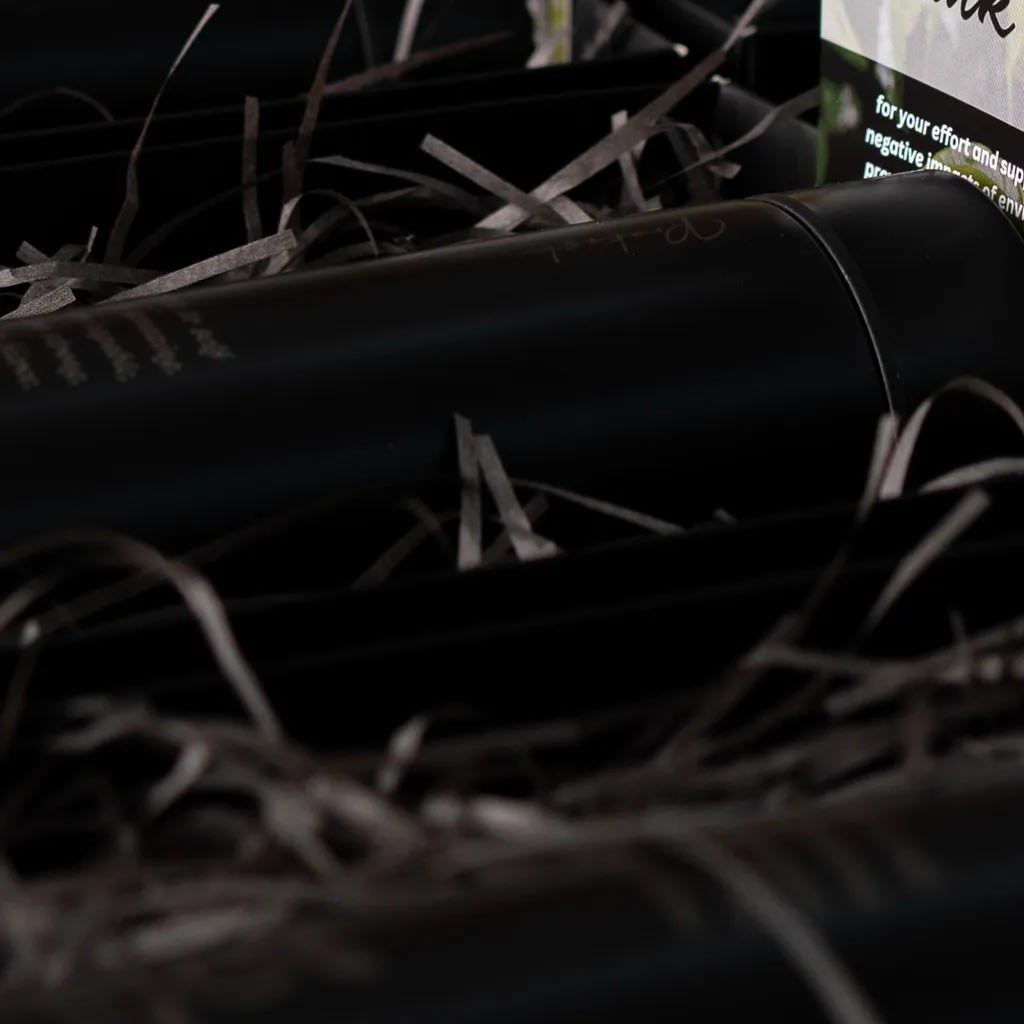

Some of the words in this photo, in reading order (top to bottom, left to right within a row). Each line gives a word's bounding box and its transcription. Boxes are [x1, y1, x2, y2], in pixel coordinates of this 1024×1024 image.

[864, 127, 925, 168] negative
[875, 94, 898, 121] for
[896, 107, 931, 136] your
[931, 123, 971, 157] effort
[972, 143, 1000, 171] and
